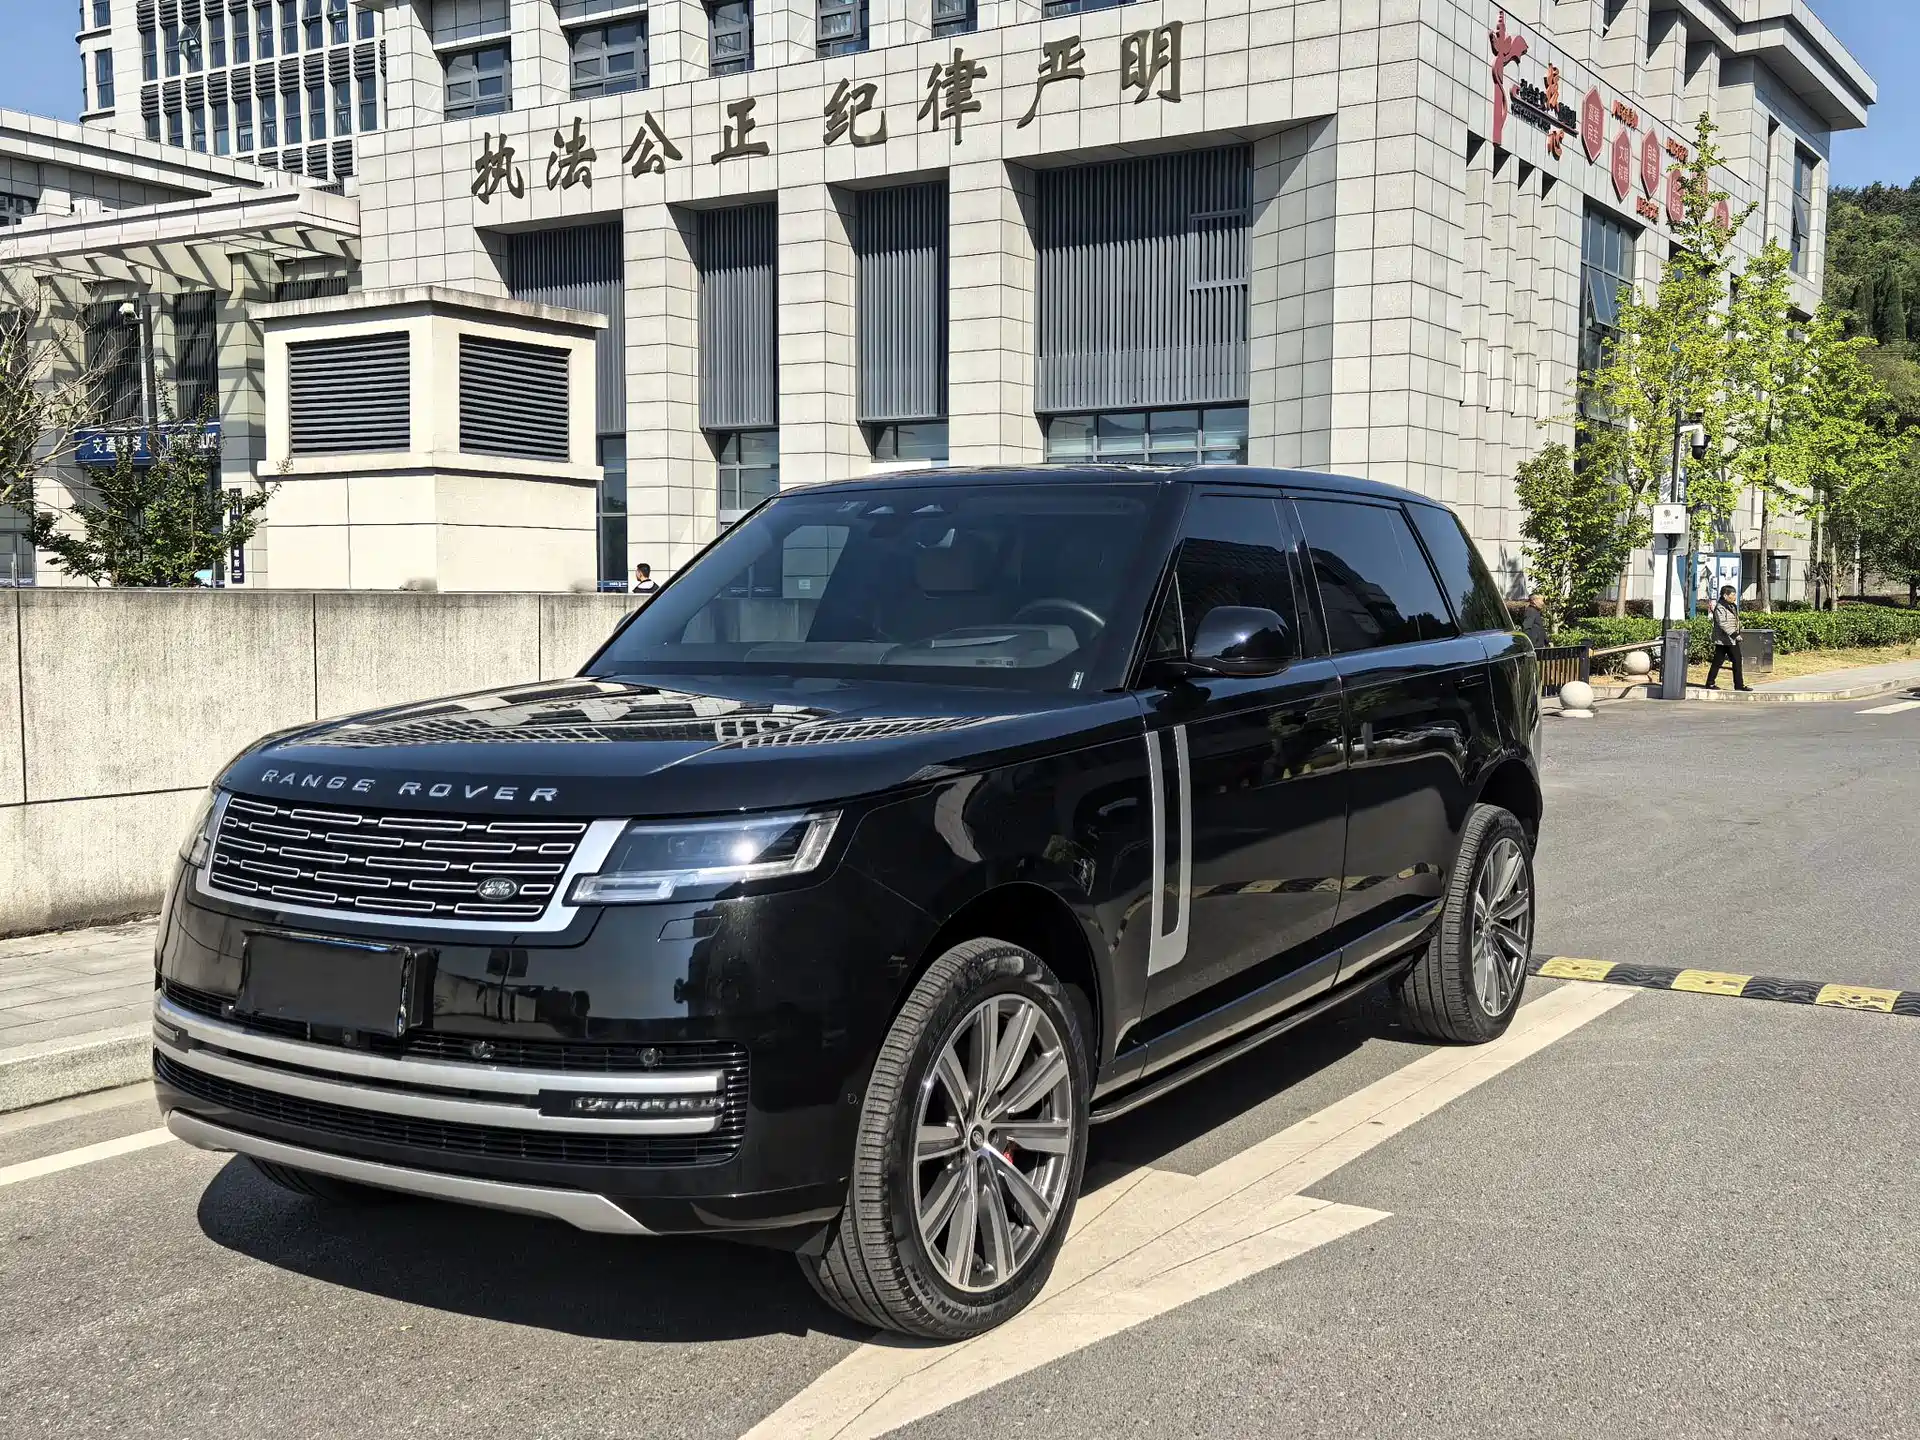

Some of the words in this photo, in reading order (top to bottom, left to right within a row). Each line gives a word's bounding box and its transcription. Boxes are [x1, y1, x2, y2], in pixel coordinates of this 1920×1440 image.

[471, 98, 770, 204] 执法公正
[823, 20, 1183, 147] 纪律严明
[261, 769, 376, 793] RANGE
[398, 781, 559, 802] ROVER
[485, 881, 506, 889] LAND
[485, 888, 510, 896] ROVER
